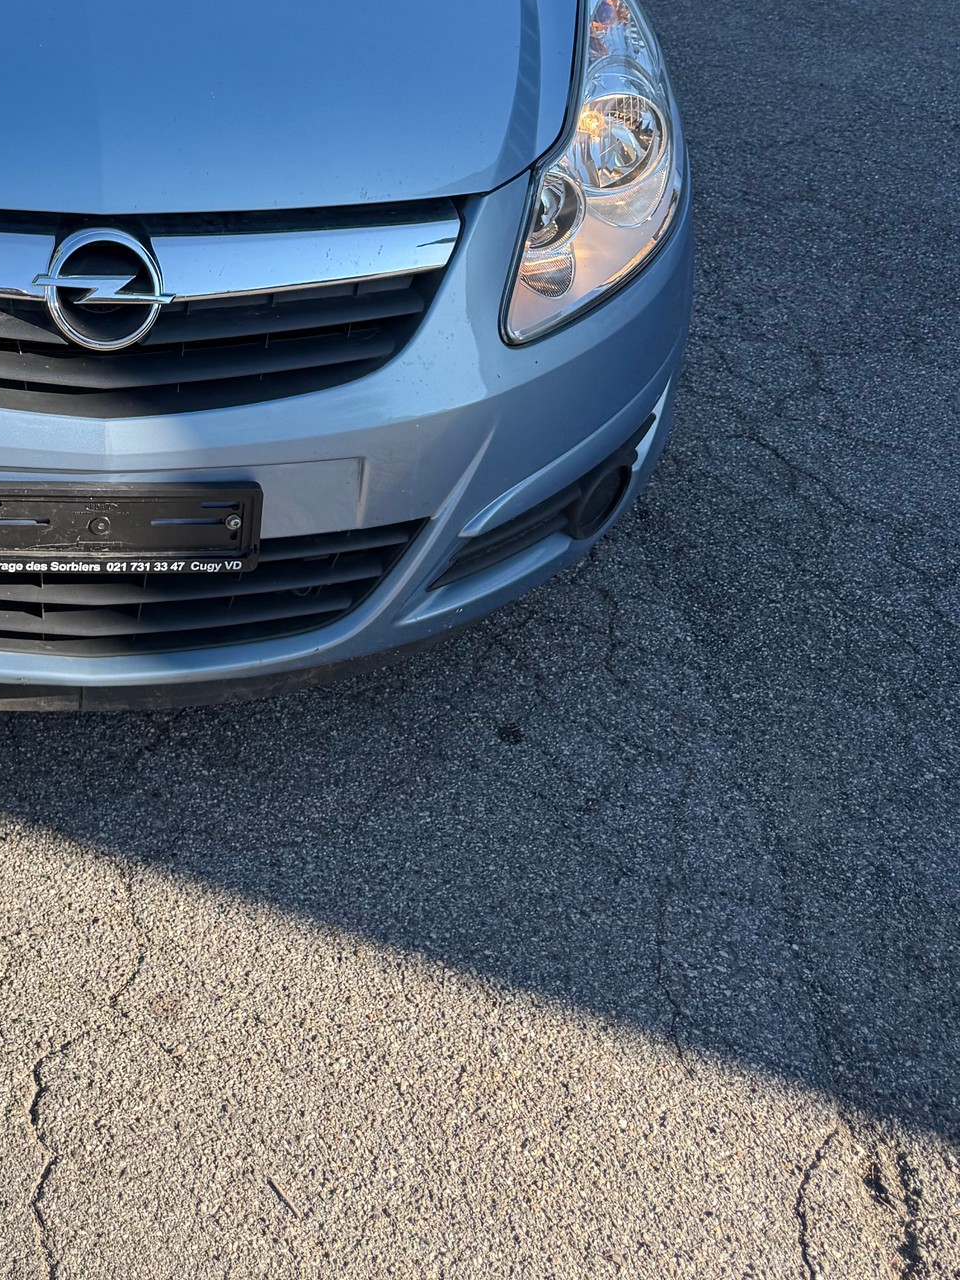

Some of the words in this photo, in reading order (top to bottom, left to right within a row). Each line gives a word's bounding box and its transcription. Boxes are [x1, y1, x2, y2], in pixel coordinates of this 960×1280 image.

[26, 561, 48, 572] des
[50, 561, 101, 572] Sorbiers
[106, 562, 127, 572] 021
[130, 562, 150, 572] 731
[153, 562, 168, 572] 33
[170, 562, 185, 571] 47
[190, 561, 222, 572] Cugy
[224, 561, 242, 570] VD
